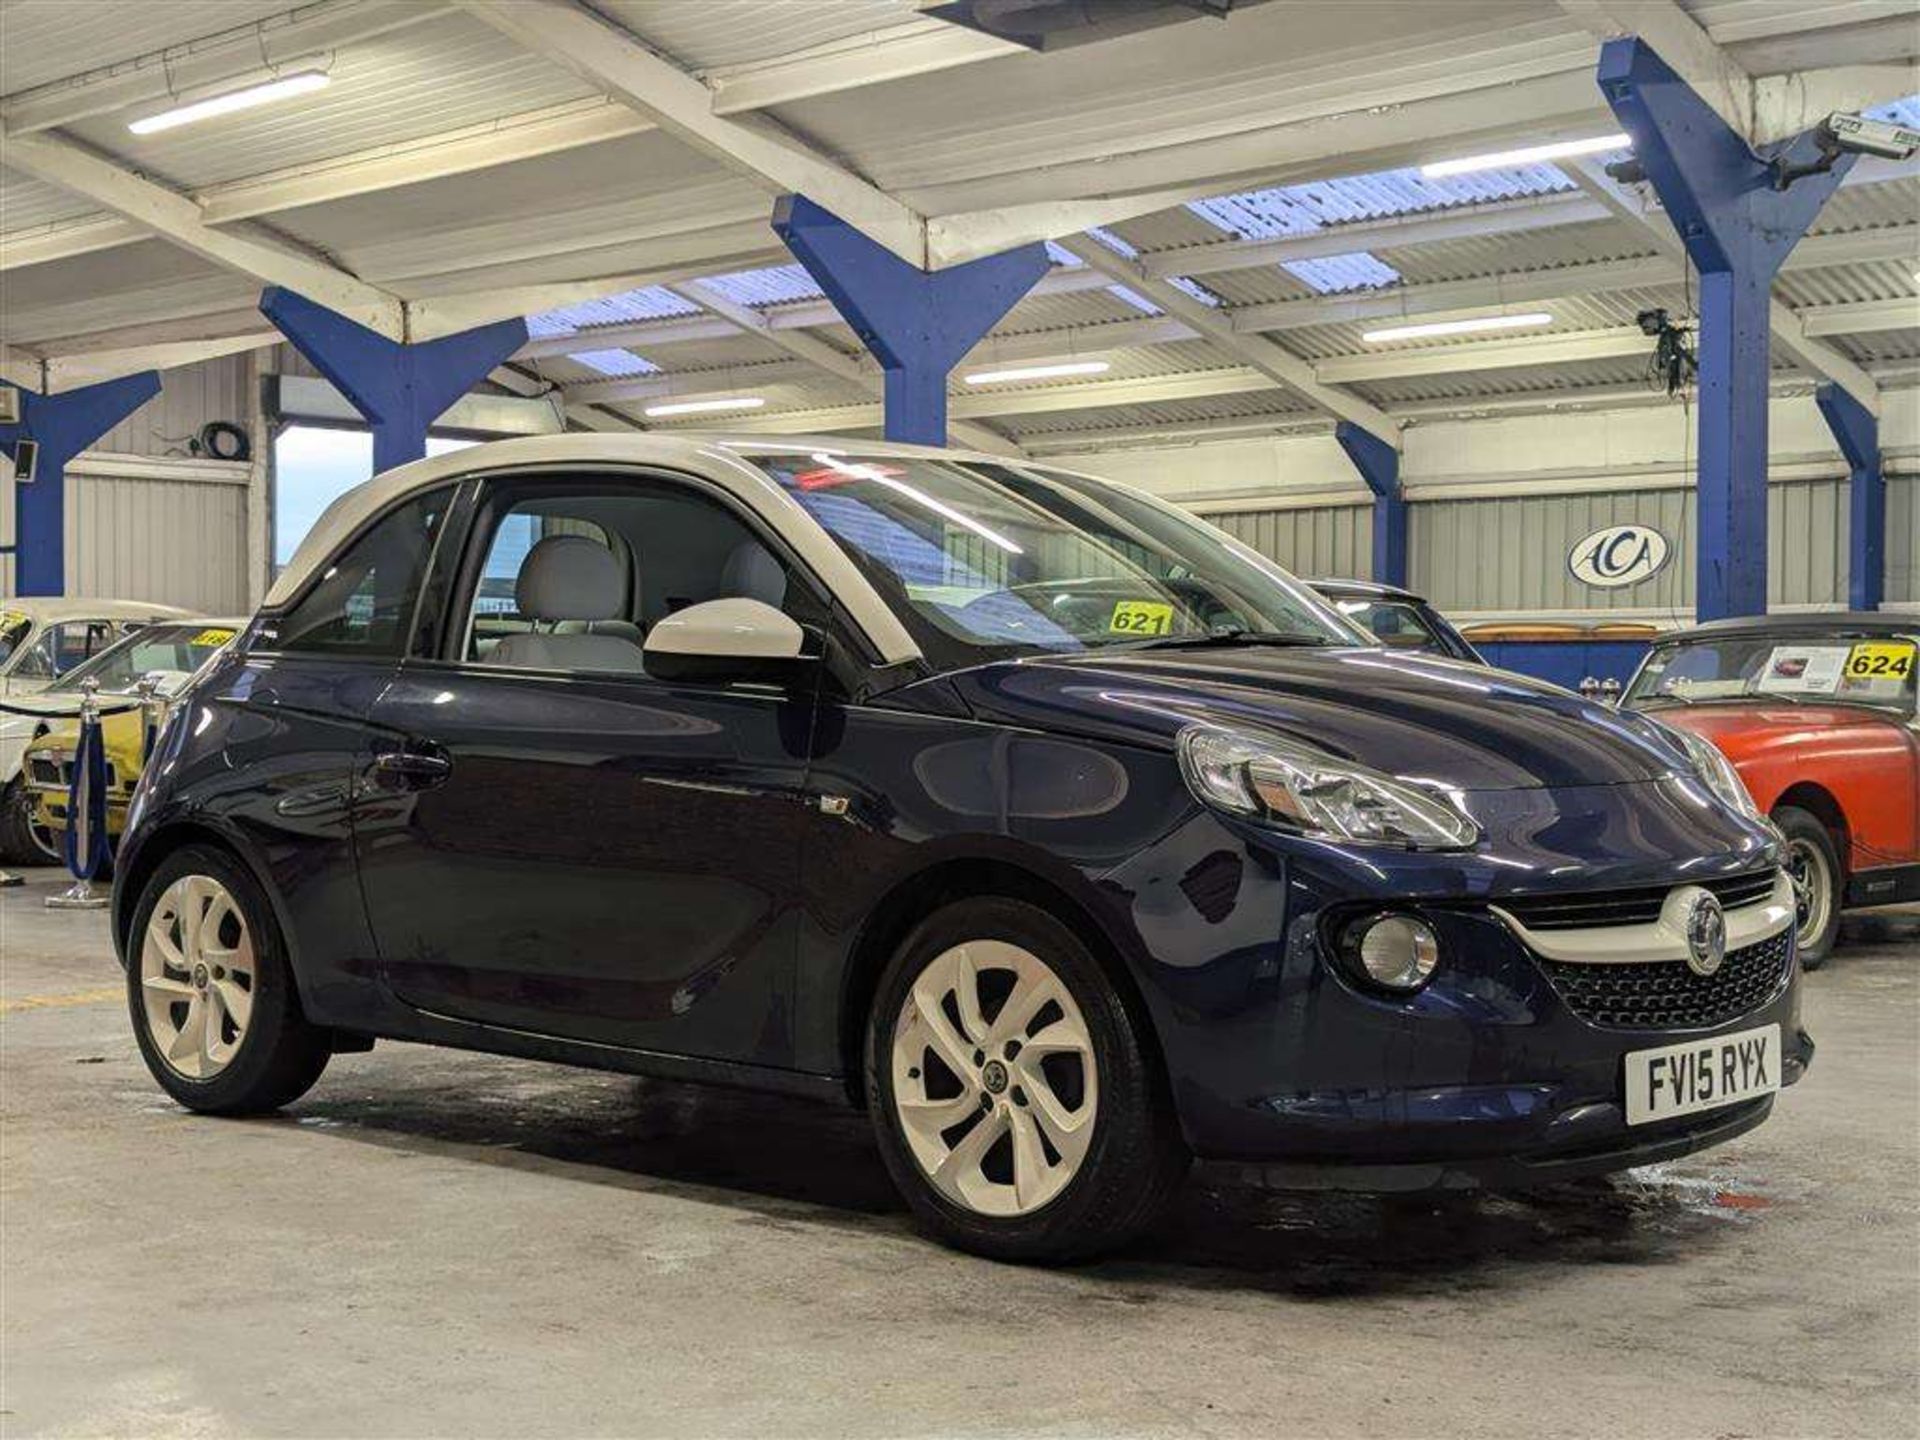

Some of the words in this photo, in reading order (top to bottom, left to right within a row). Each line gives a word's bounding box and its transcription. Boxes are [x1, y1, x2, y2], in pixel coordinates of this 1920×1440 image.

[1575, 531, 1652, 577] ACA
[1114, 612, 1165, 634] 621
[1853, 656, 1908, 675] 624
[1649, 1049, 1713, 1111] FV15
[1721, 1037, 1767, 1096] RYX
